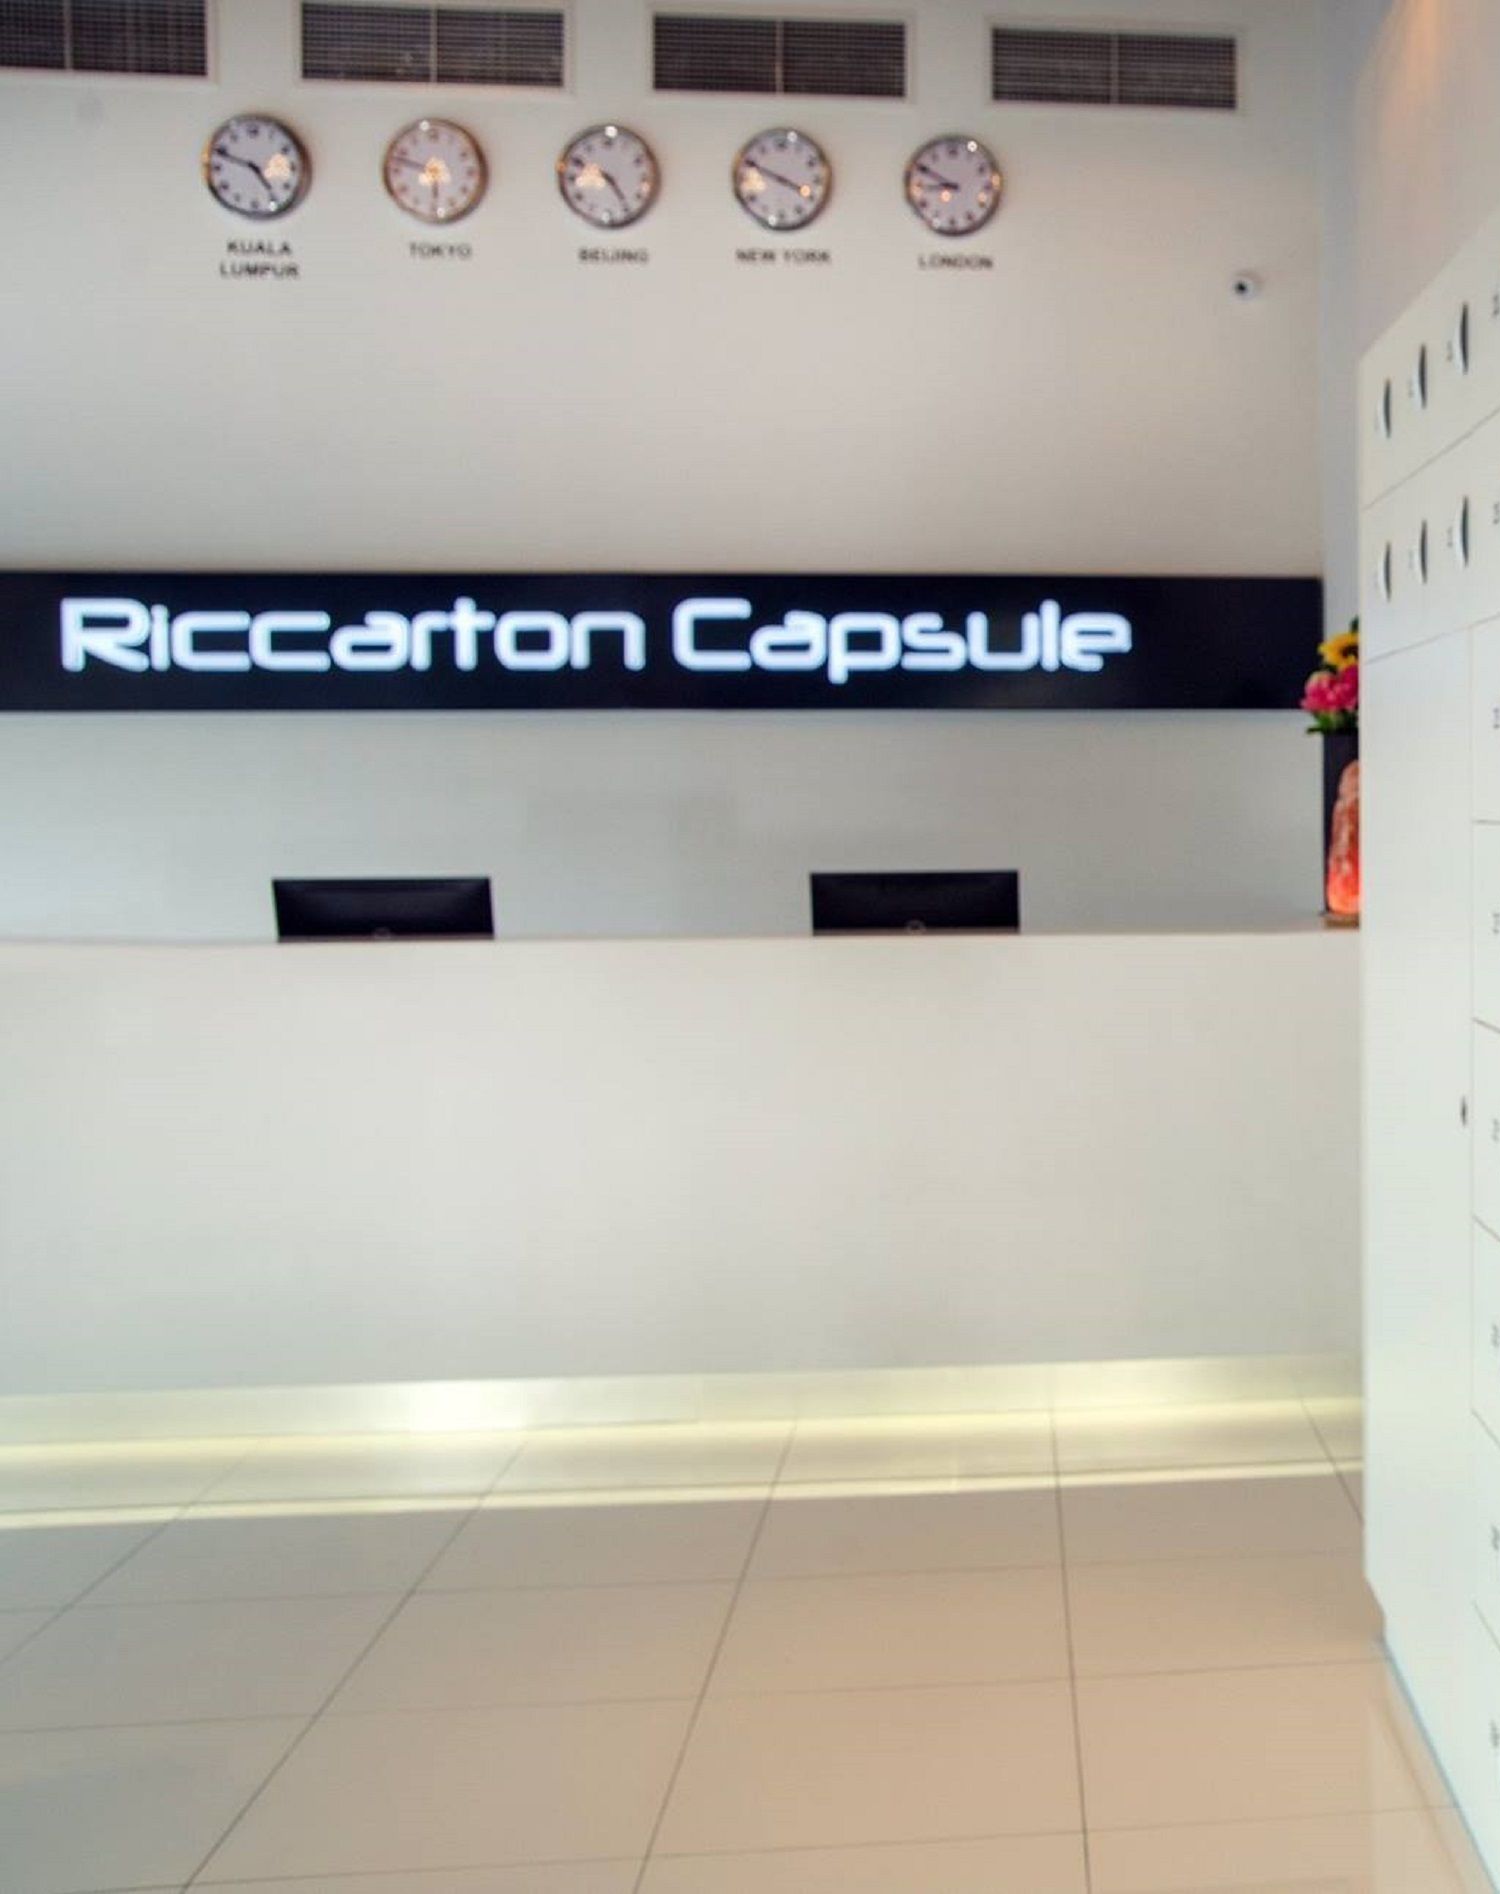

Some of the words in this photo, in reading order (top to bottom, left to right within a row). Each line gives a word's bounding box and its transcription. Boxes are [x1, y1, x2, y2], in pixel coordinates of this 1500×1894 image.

[226, 241, 291, 256] KUALA
[409, 242, 473, 259] TOKYO
[578, 247, 650, 265] BEIJING
[736, 249, 778, 265] NEW
[783, 249, 832, 265] YORK
[219, 261, 299, 278] LUMPUR
[917, 254, 993, 270] LONDON
[60, 596, 646, 672] Riccarton
[672, 596, 1134, 684] Capsule
